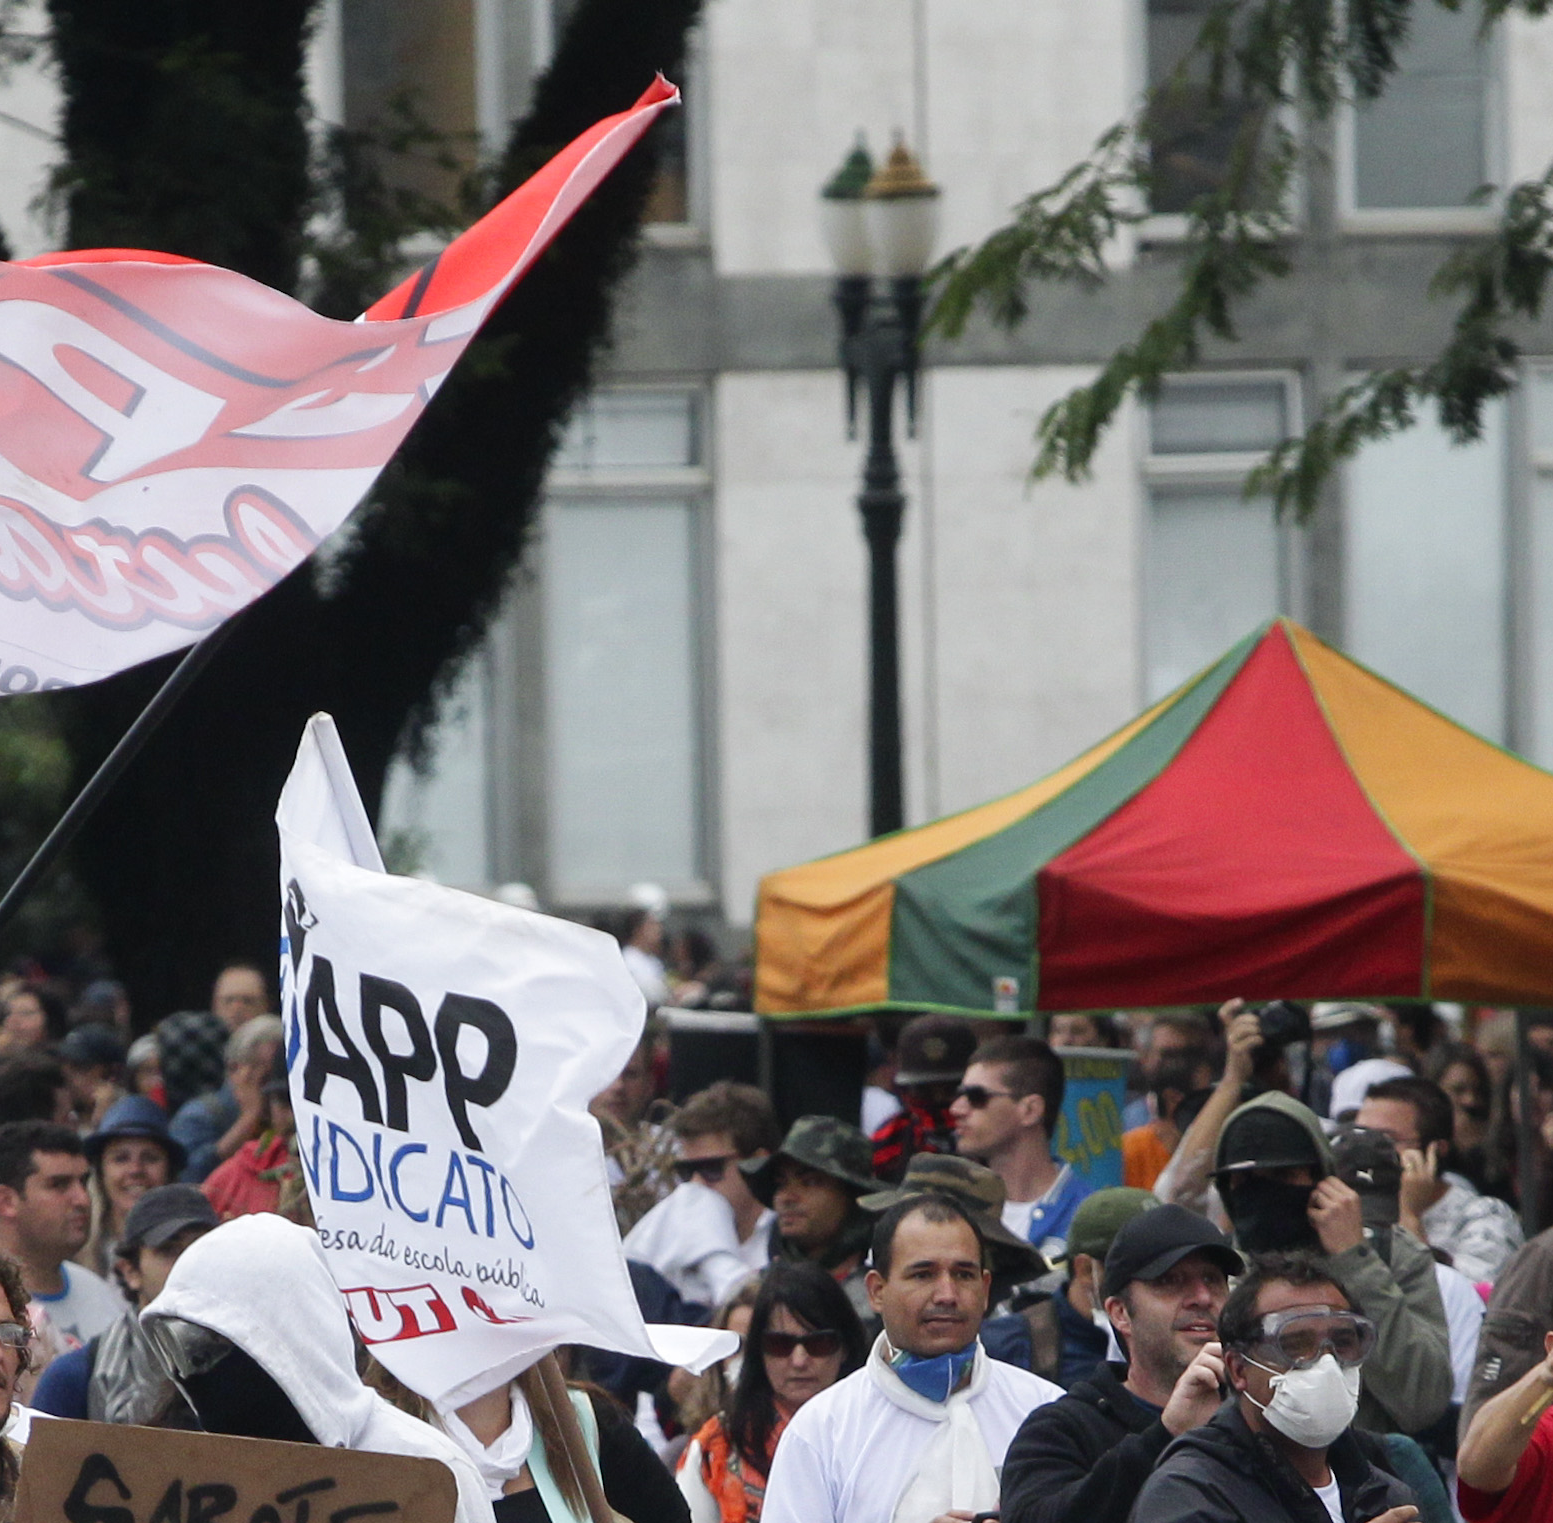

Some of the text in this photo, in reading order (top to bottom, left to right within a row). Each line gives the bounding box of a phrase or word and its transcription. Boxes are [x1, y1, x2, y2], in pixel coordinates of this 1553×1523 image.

[303, 954, 518, 1152] APP
[370, 1223, 399, 1262] da
[404, 1246, 472, 1279] escola
[343, 1289, 443, 1342] UT
